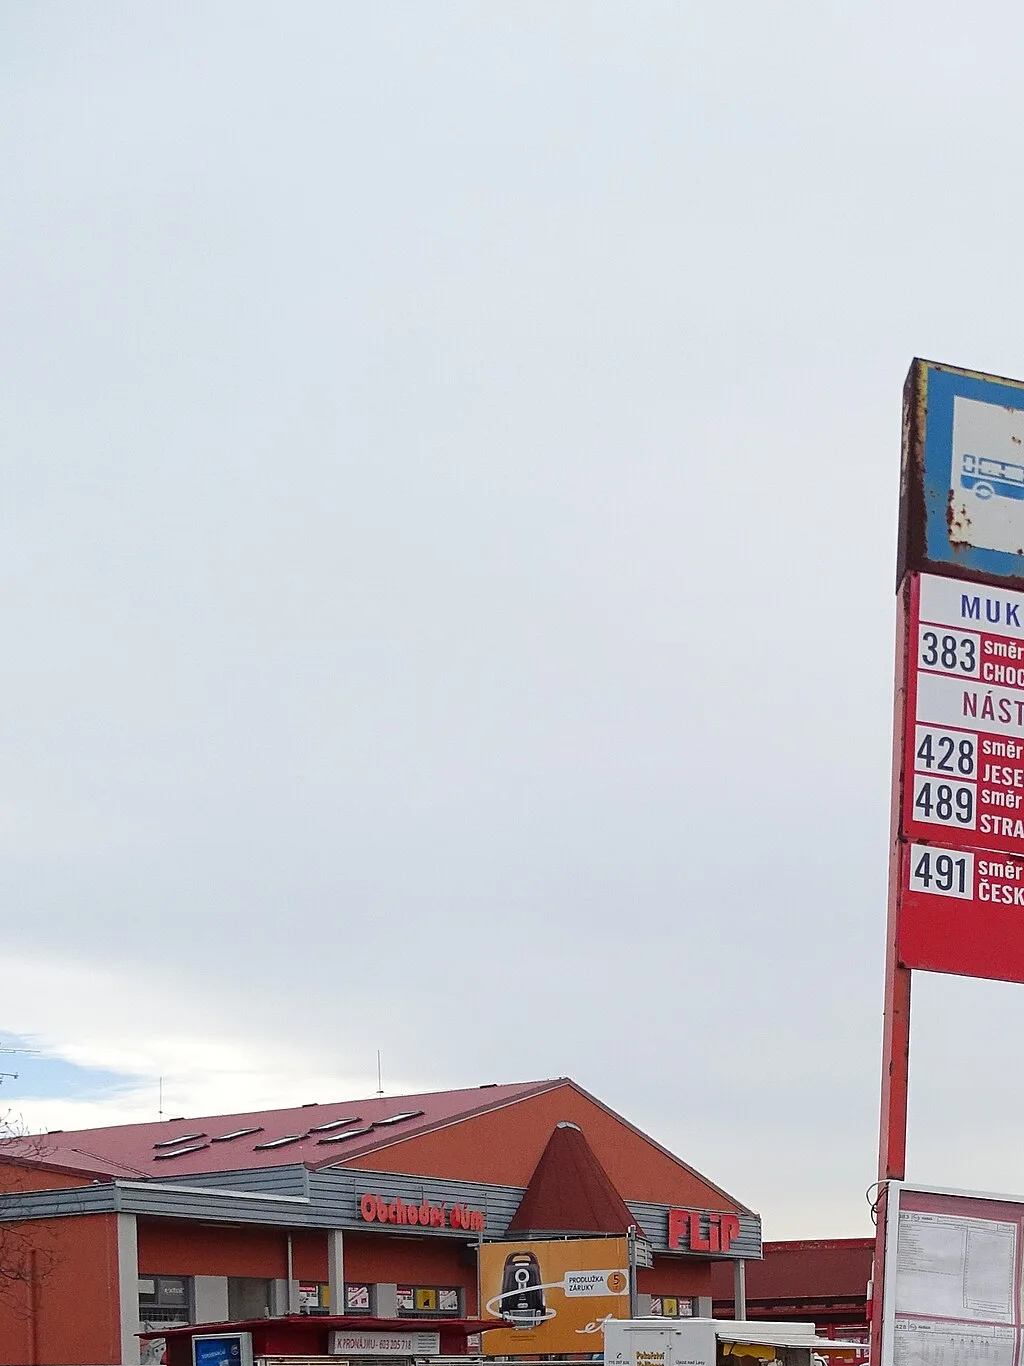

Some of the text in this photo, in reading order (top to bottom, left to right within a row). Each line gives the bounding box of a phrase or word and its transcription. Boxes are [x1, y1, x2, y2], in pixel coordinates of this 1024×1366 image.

[922, 632, 976, 673] 383
[984, 640, 1024, 660] směr
[917, 734, 974, 775] 428
[982, 739, 1024, 760] směr
[915, 782, 973, 824] 489
[981, 789, 1023, 809] směr
[914, 852, 966, 894] 491
[978, 860, 1023, 880] směr
[360, 1192, 486, 1231] Obchodní dům
[569, 1274, 620, 1285] PRODLUŽKA 5
